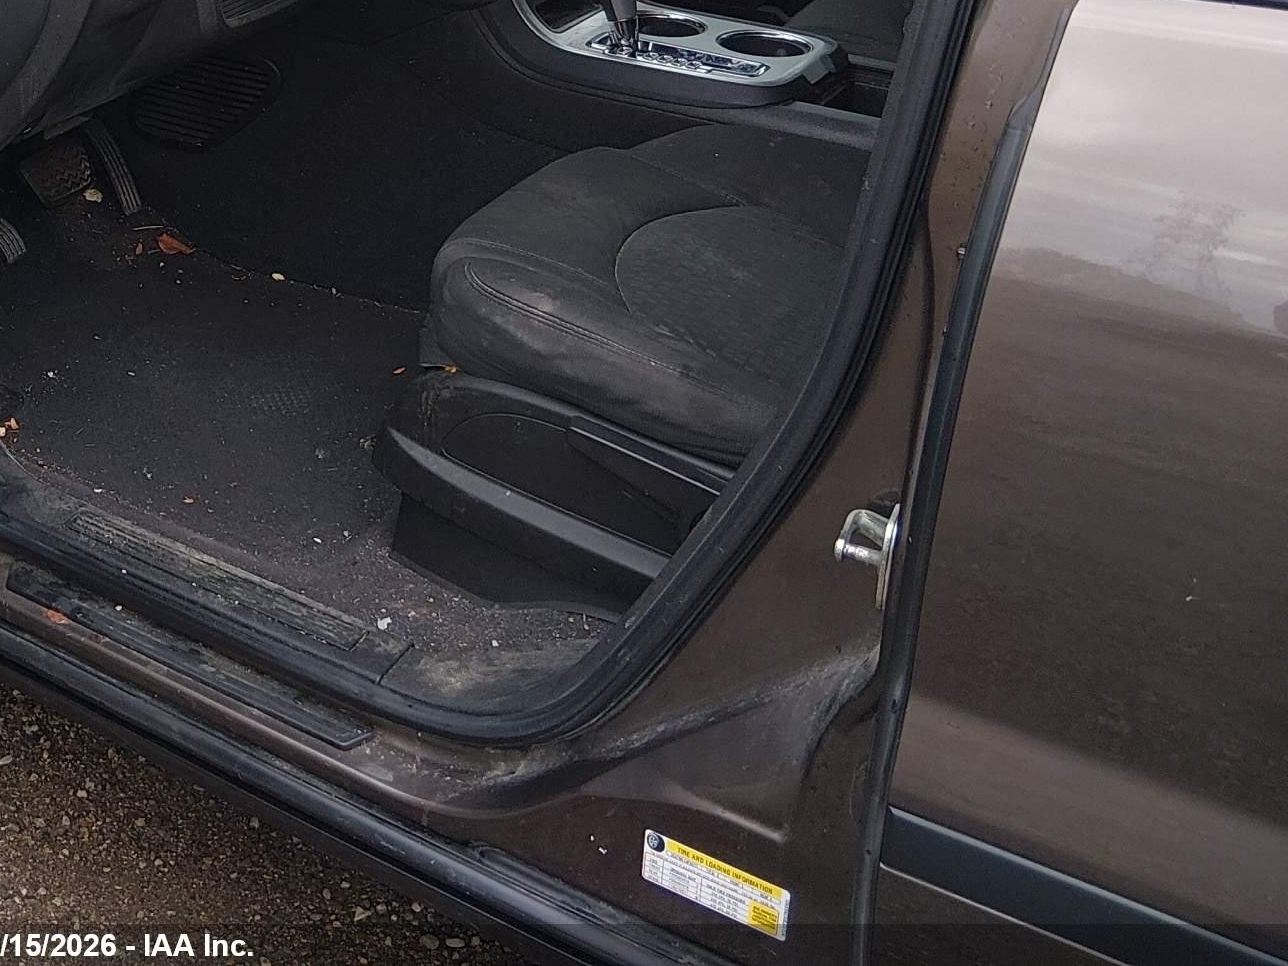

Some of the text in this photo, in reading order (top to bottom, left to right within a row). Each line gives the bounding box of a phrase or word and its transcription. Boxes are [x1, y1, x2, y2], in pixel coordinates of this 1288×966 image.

[678, 848, 773, 894] TIRE AND LOADING INFORMATION
